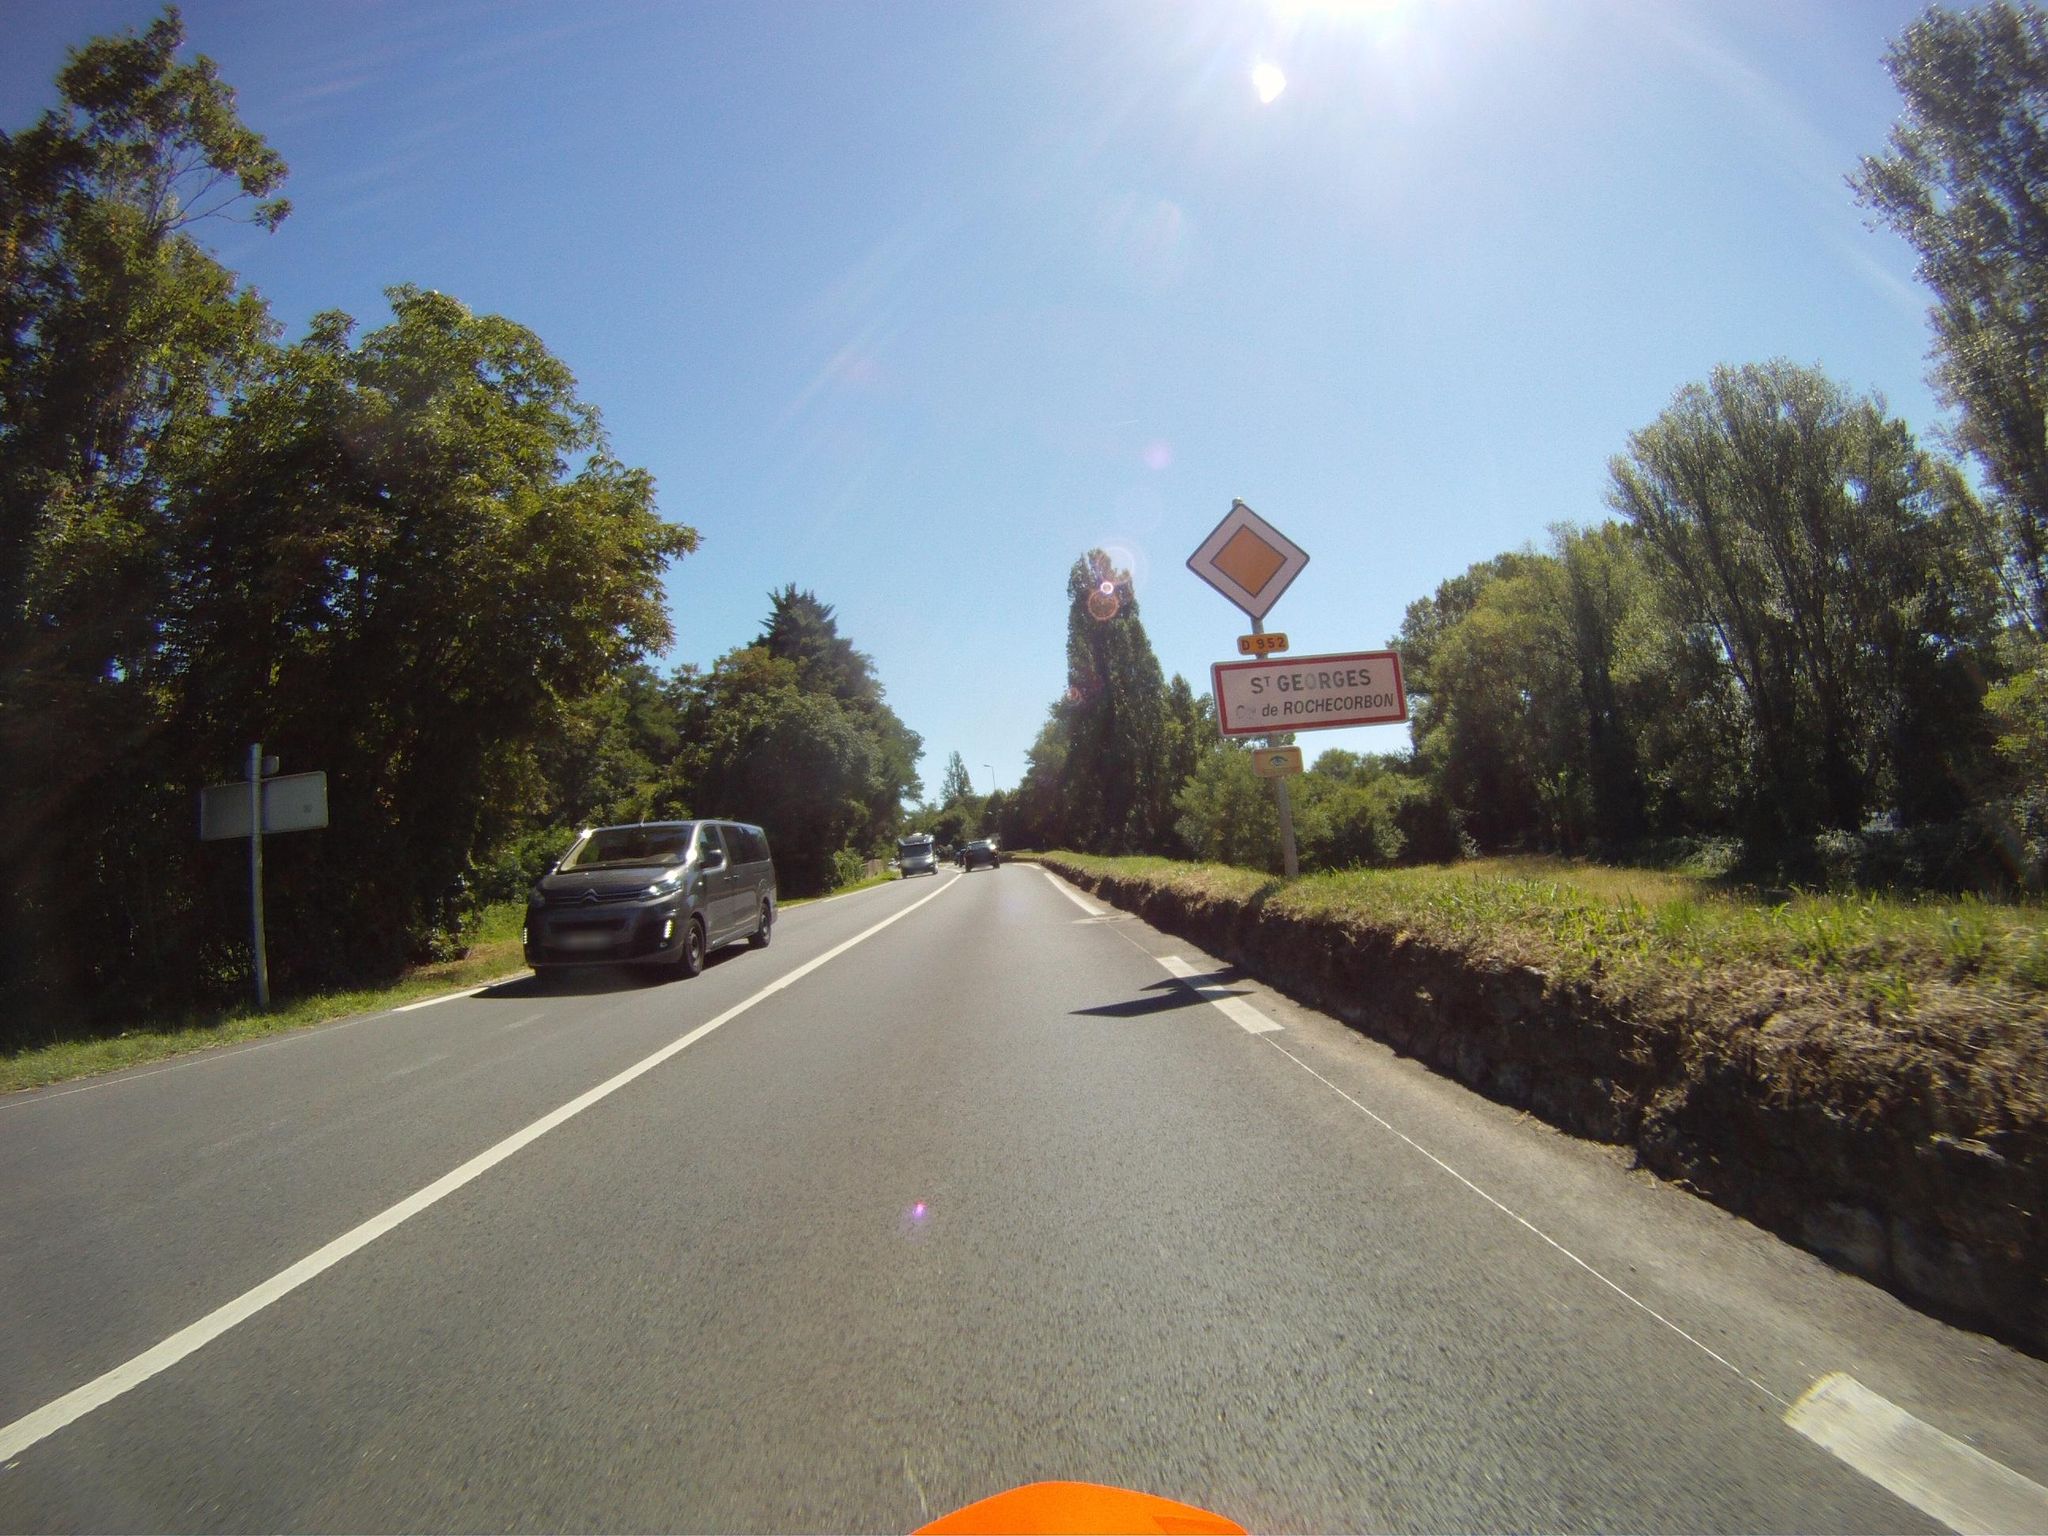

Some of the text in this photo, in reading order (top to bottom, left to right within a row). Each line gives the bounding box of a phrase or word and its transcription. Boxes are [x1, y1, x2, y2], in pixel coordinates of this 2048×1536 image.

[1242, 637, 1286, 650] D 952
[1277, 669, 1371, 692] GEORGES
[1262, 703, 1278, 717] de
[1283, 693, 1394, 715] ROCHECORBON
